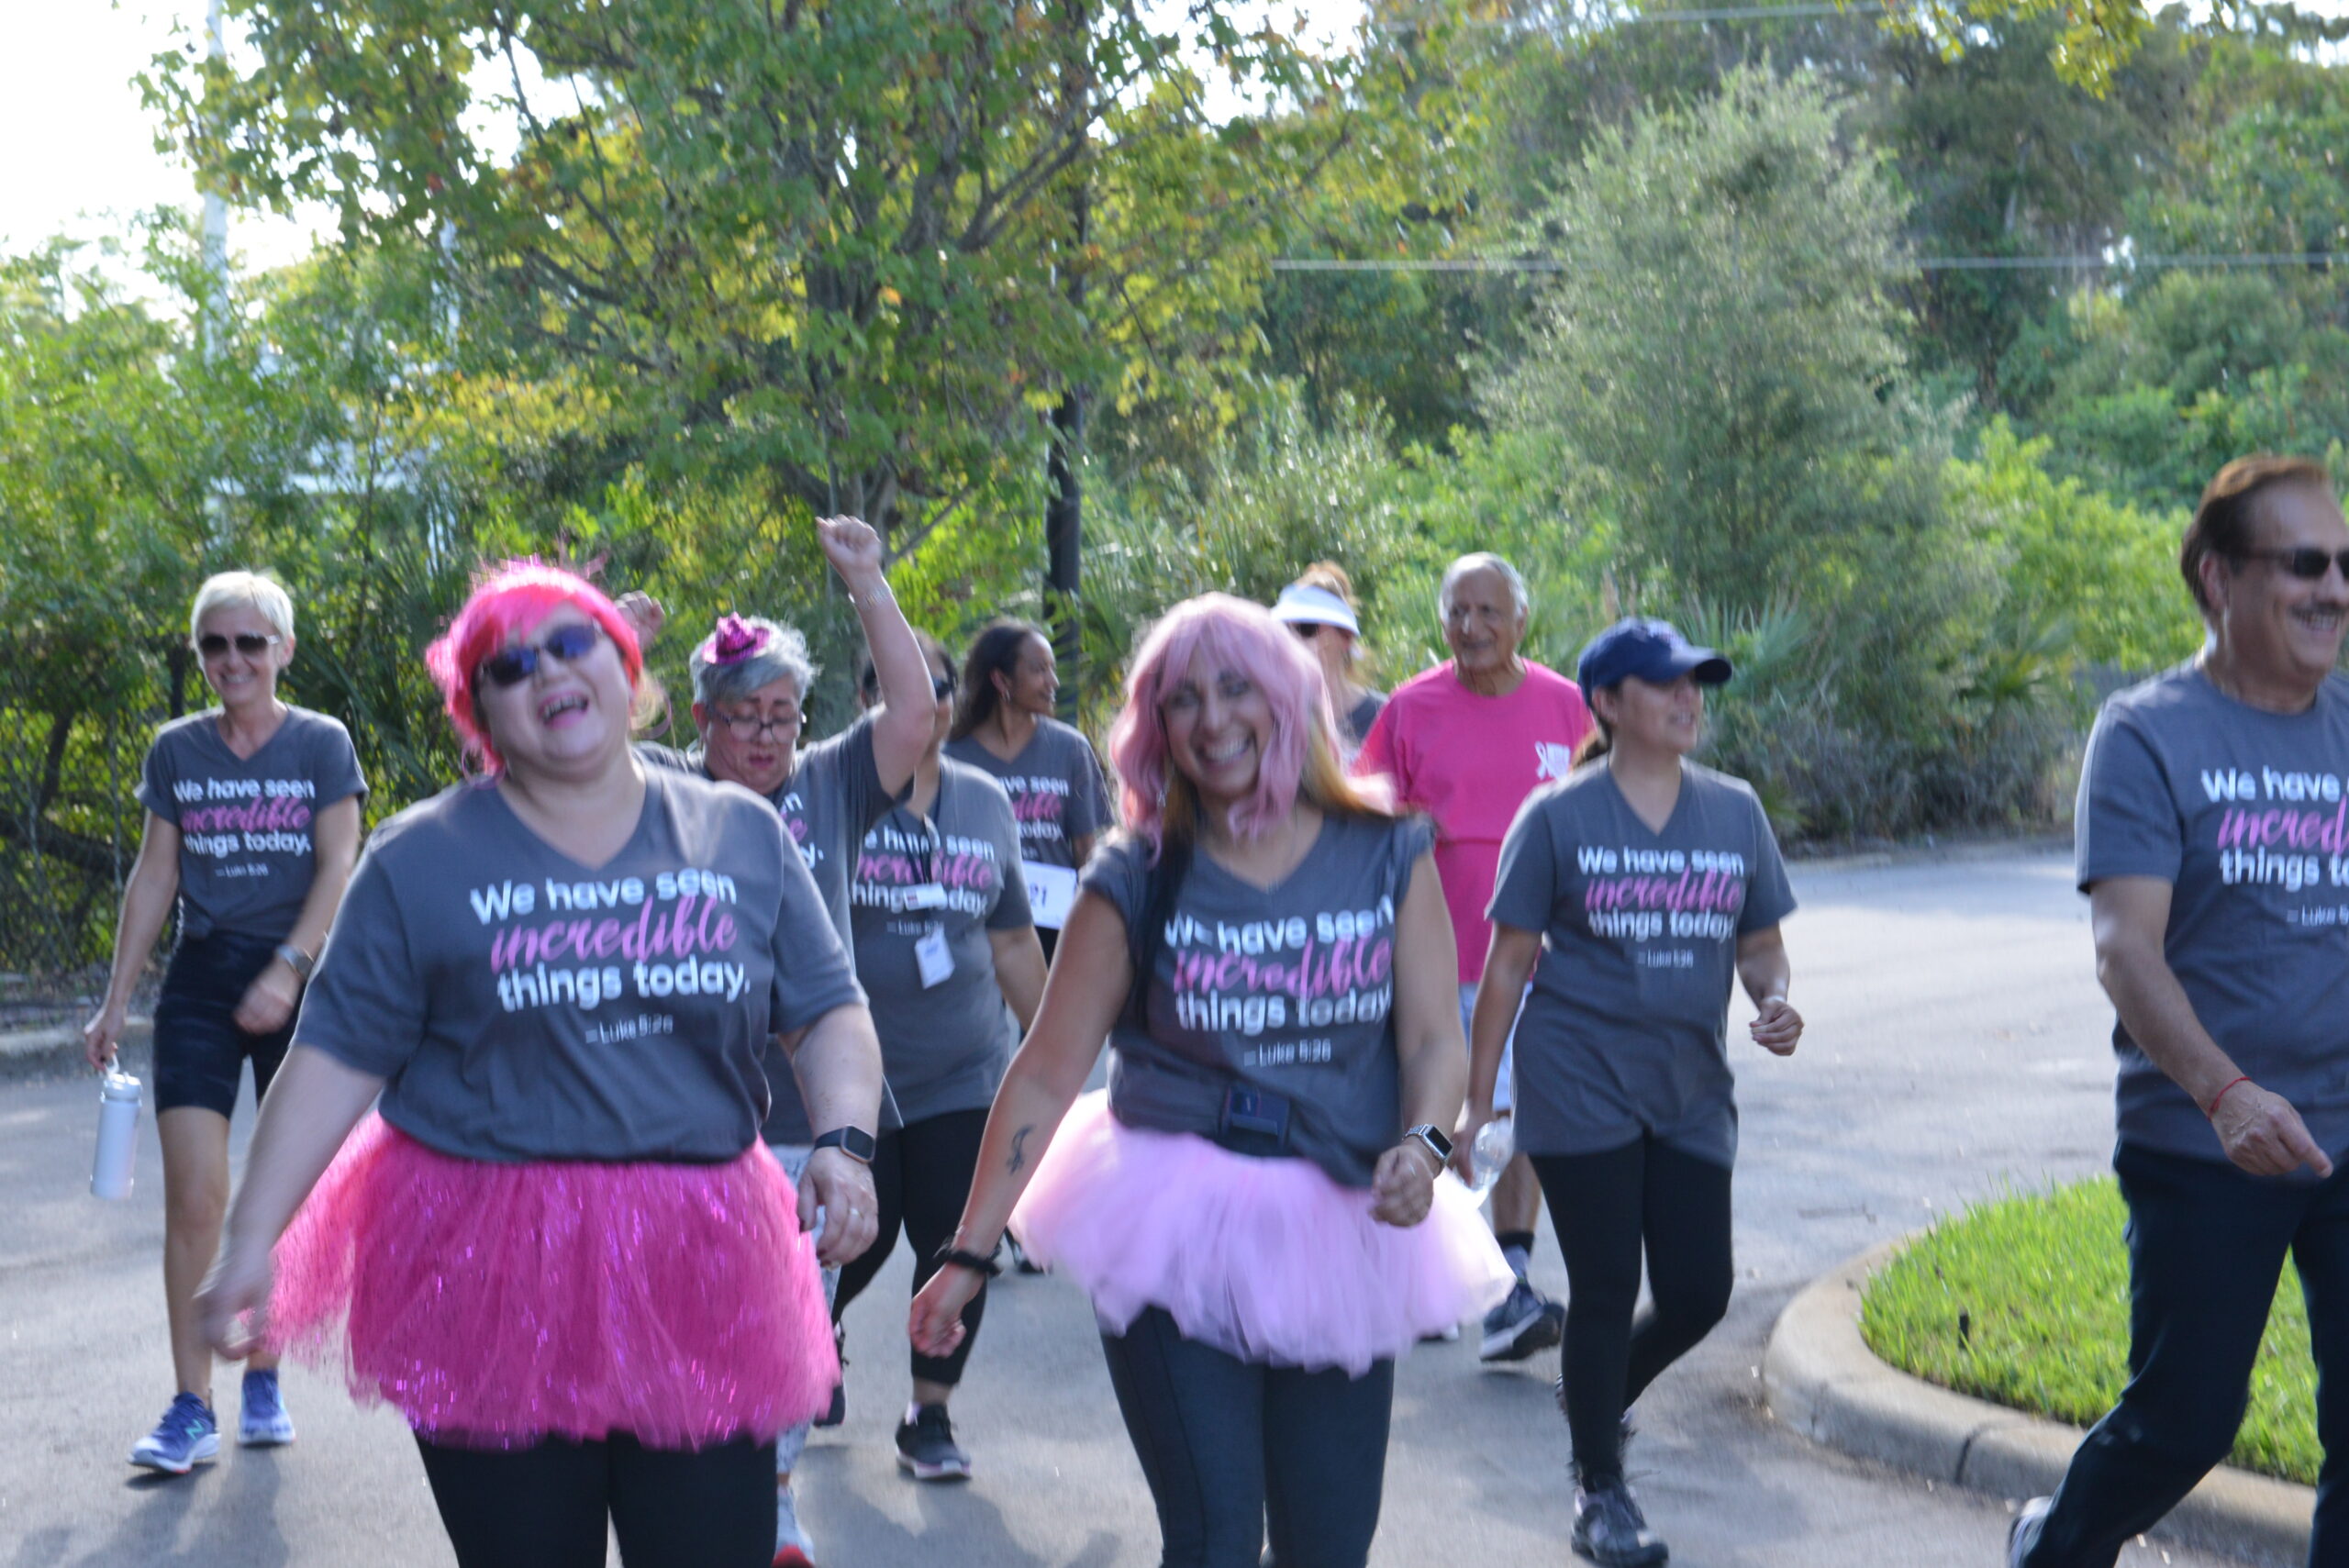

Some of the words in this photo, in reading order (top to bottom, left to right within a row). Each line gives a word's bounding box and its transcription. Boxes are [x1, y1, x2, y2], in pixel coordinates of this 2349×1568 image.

[173, 779, 204, 804] We
[207, 776, 262, 800] have
[264, 778, 316, 798] seen
[1030, 776, 1069, 797] seen
[2201, 767, 2256, 804] We
[2262, 764, 2340, 804] have
[184, 832, 240, 860] things
[2217, 795, 2349, 855] incred
[946, 835, 995, 862] seen
[1577, 845, 1618, 875] We
[1623, 844, 1686, 873] have
[1691, 849, 1744, 878] seen
[2220, 844, 2320, 893] things
[470, 878, 536, 926] We
[545, 876, 645, 911] have
[656, 866, 737, 905] seen
[1585, 863, 1741, 912] incredible
[490, 894, 738, 975] incredible
[1217, 915, 1307, 957] have
[1316, 894, 1394, 944] seen
[1588, 906, 1663, 942] things
[497, 961, 622, 1013] things
[1174, 932, 1393, 998] incredible
[599, 1019, 637, 1044] Luke
[1175, 988, 1286, 1037] things
[1259, 1041, 1295, 1068] Luke
